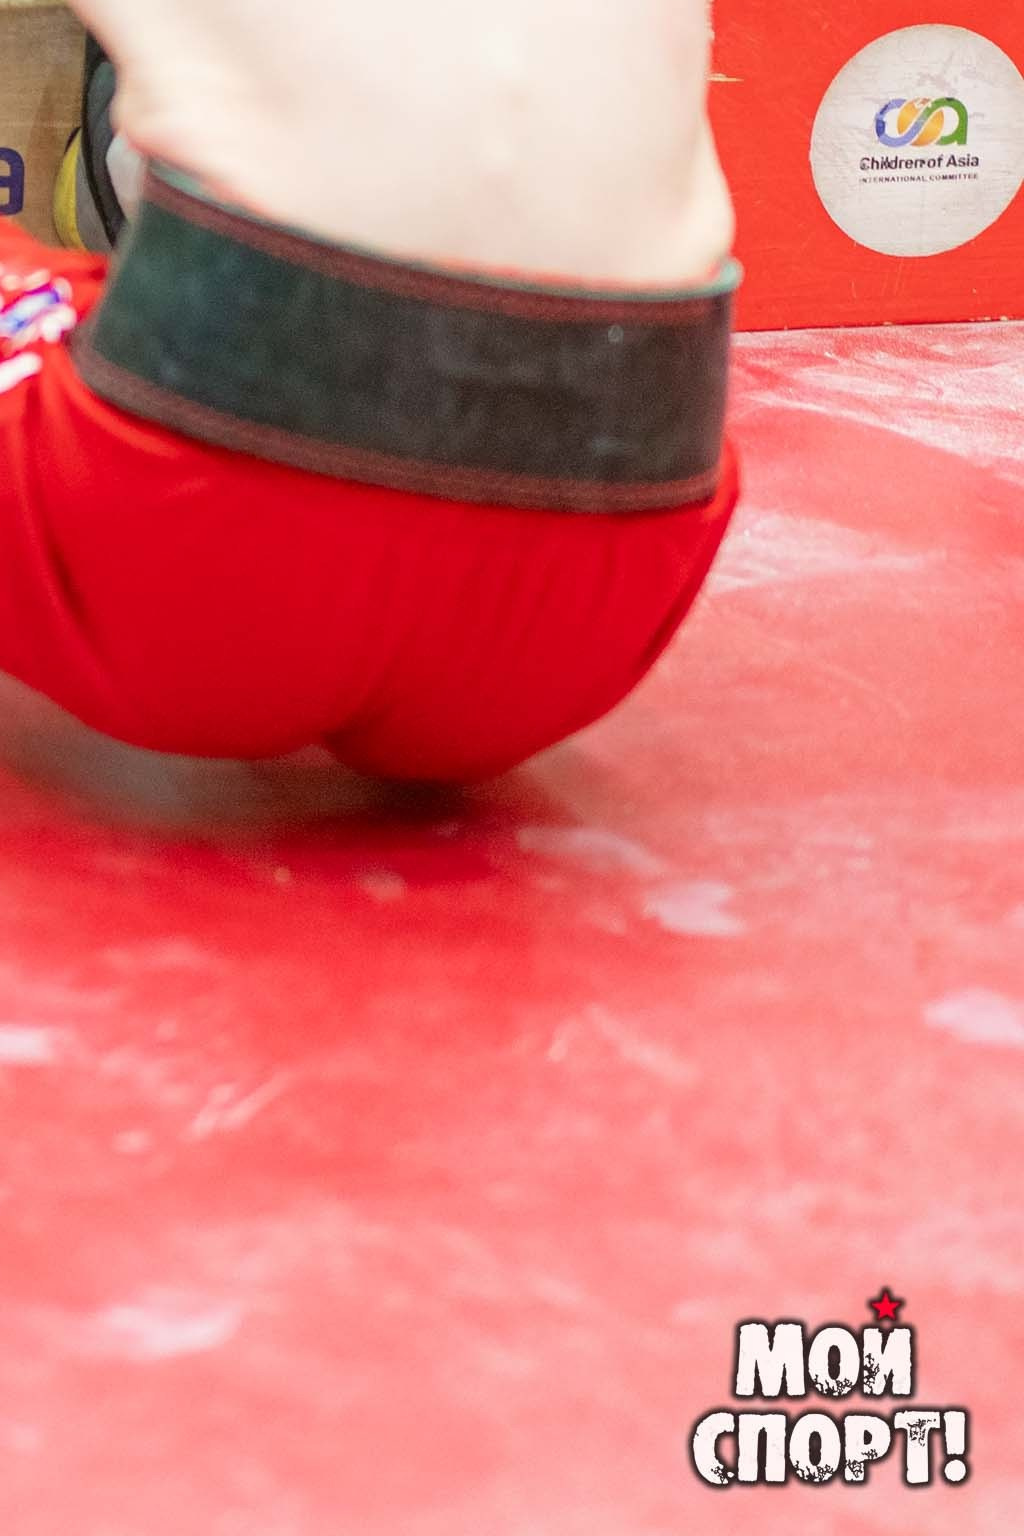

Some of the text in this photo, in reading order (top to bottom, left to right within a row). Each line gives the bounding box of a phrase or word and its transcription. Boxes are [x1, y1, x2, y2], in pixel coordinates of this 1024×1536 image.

[860, 154, 980, 170] Children of Asia
